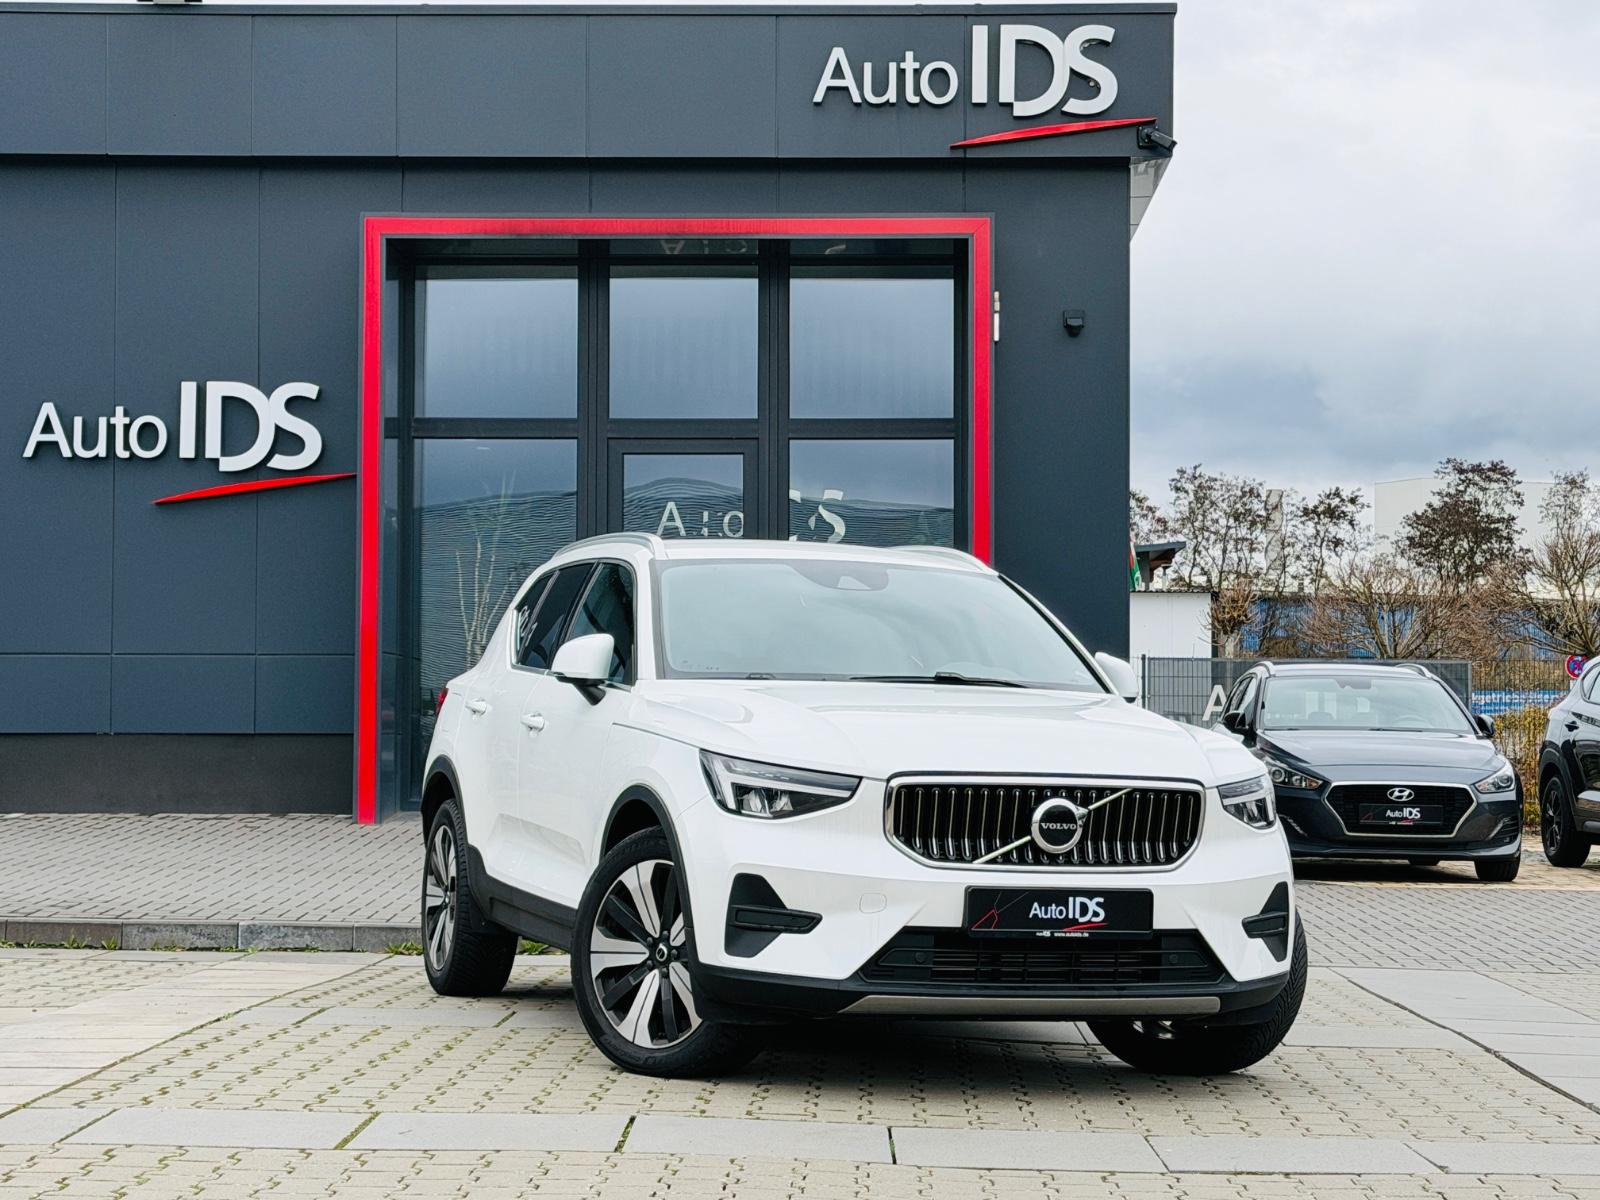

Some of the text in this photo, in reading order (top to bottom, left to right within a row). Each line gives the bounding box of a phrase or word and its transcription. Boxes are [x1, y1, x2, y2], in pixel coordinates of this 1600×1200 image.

[812, 23, 1120, 118] Auto IDS
[22, 380, 324, 473] Auto IDS
[1040, 822, 1077, 830] VOLVO
[1385, 807, 1420, 818] Auto IDS
[1029, 896, 1106, 923] Auto IDS
